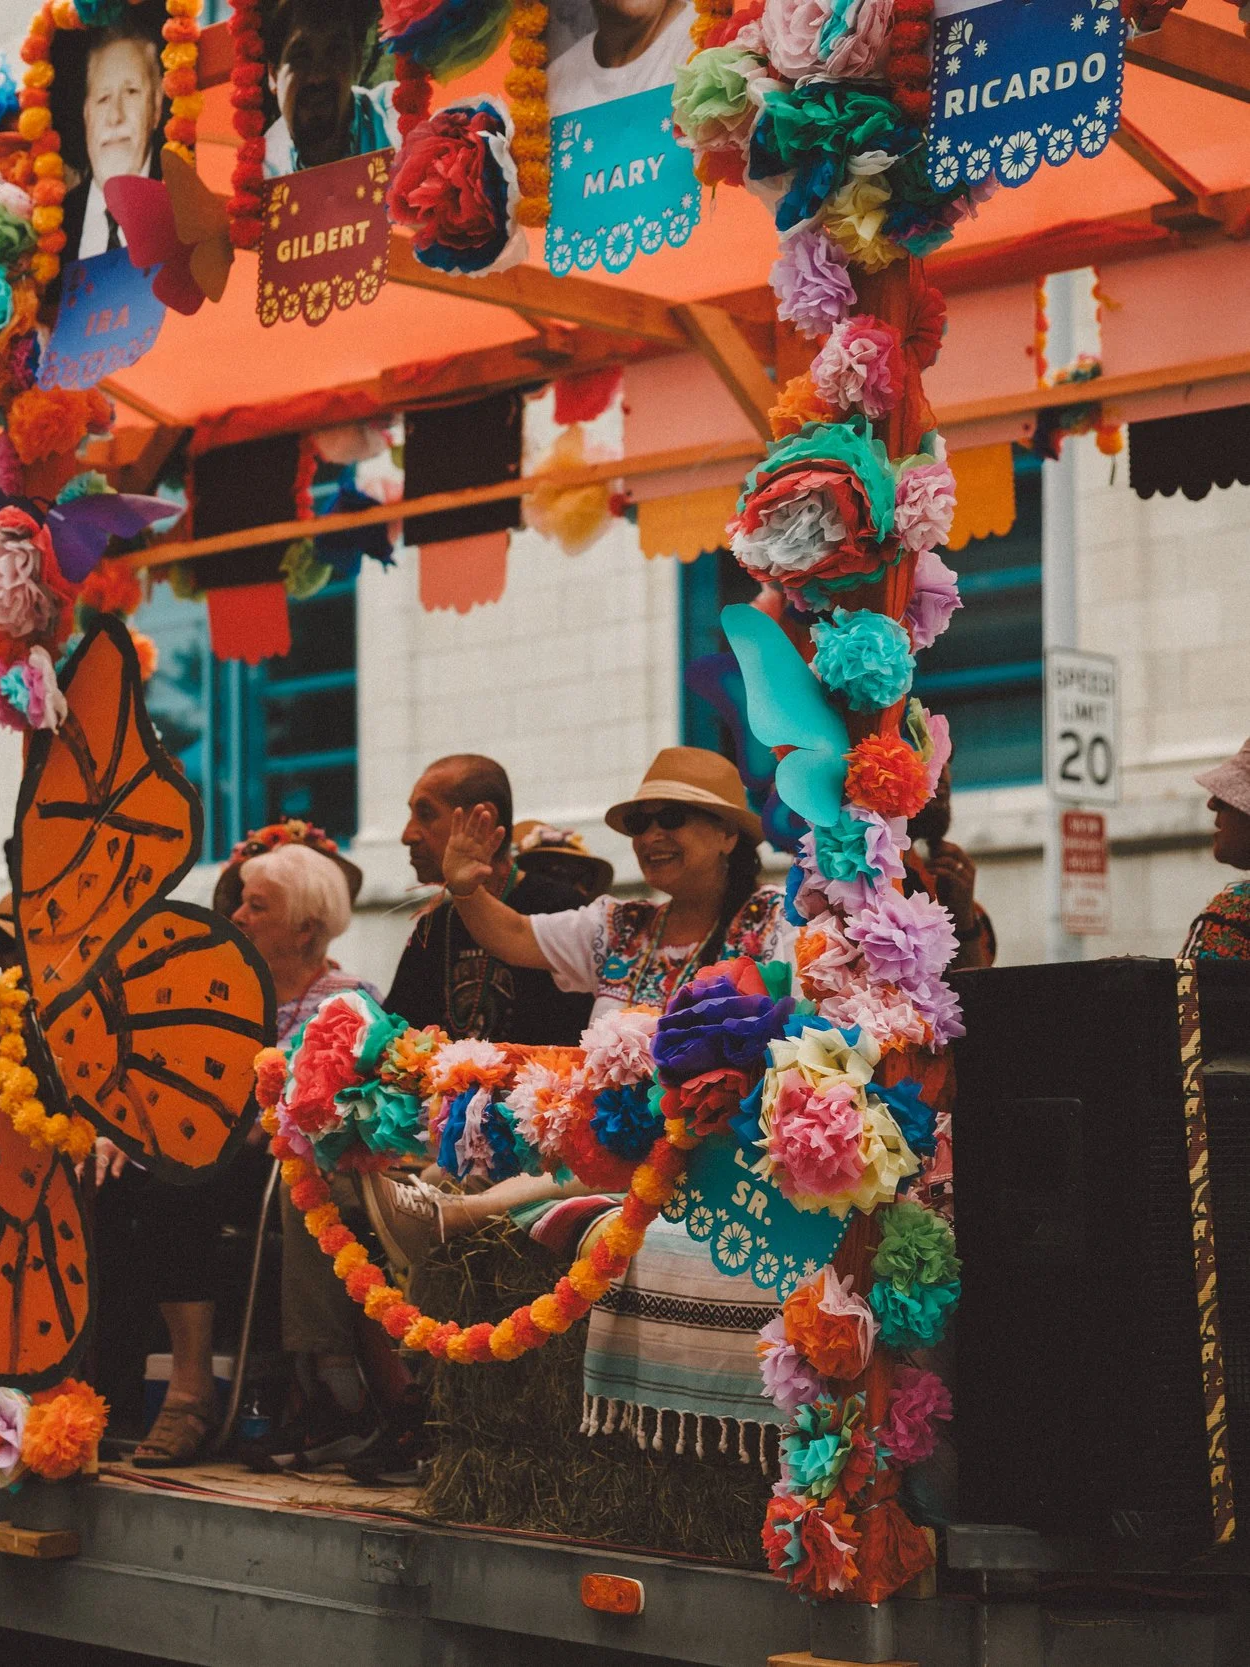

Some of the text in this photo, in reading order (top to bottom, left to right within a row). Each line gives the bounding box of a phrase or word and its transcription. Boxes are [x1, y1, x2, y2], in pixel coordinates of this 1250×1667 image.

[944, 52, 1107, 119] RICARDO
[582, 152, 665, 199] MARY
[276, 220, 370, 263] GILBERT
[84, 304, 129, 337] IRA
[1059, 730, 1113, 786] 20
[731, 1180, 772, 1226] SR.
